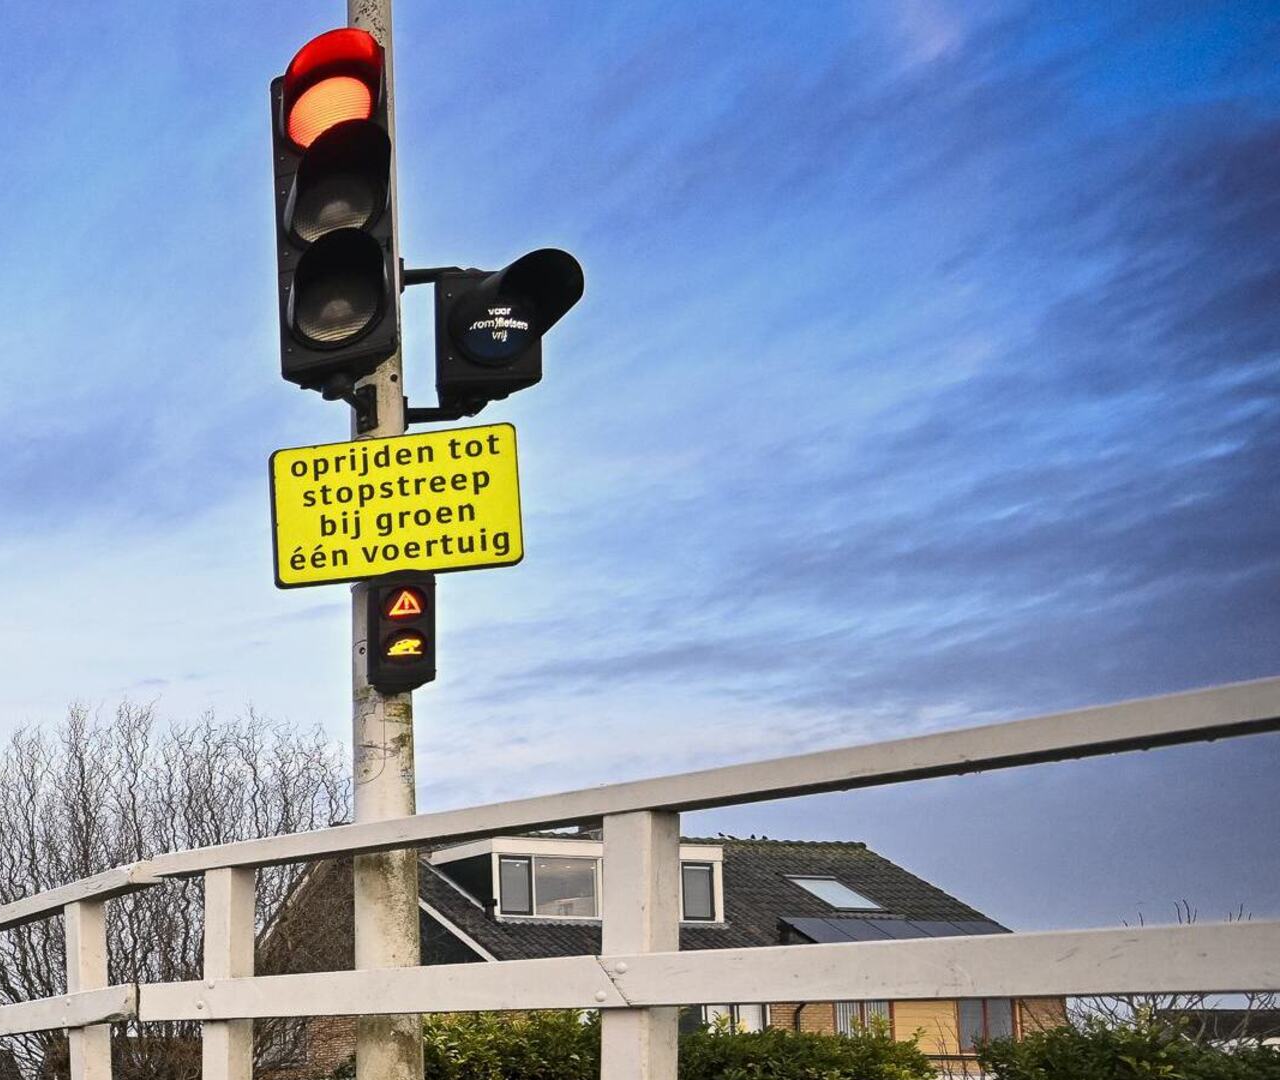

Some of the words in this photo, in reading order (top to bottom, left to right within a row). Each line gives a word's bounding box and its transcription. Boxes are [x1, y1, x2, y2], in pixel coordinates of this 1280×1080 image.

[488, 307, 512, 315] voor
[290, 445, 434, 481] oprijden
[448, 434, 500, 459] tot
[303, 470, 490, 507] stopstreep
[320, 510, 361, 540] bij
[376, 502, 476, 537] groen
[290, 545, 348, 570] één
[362, 529, 510, 563] voertuig
